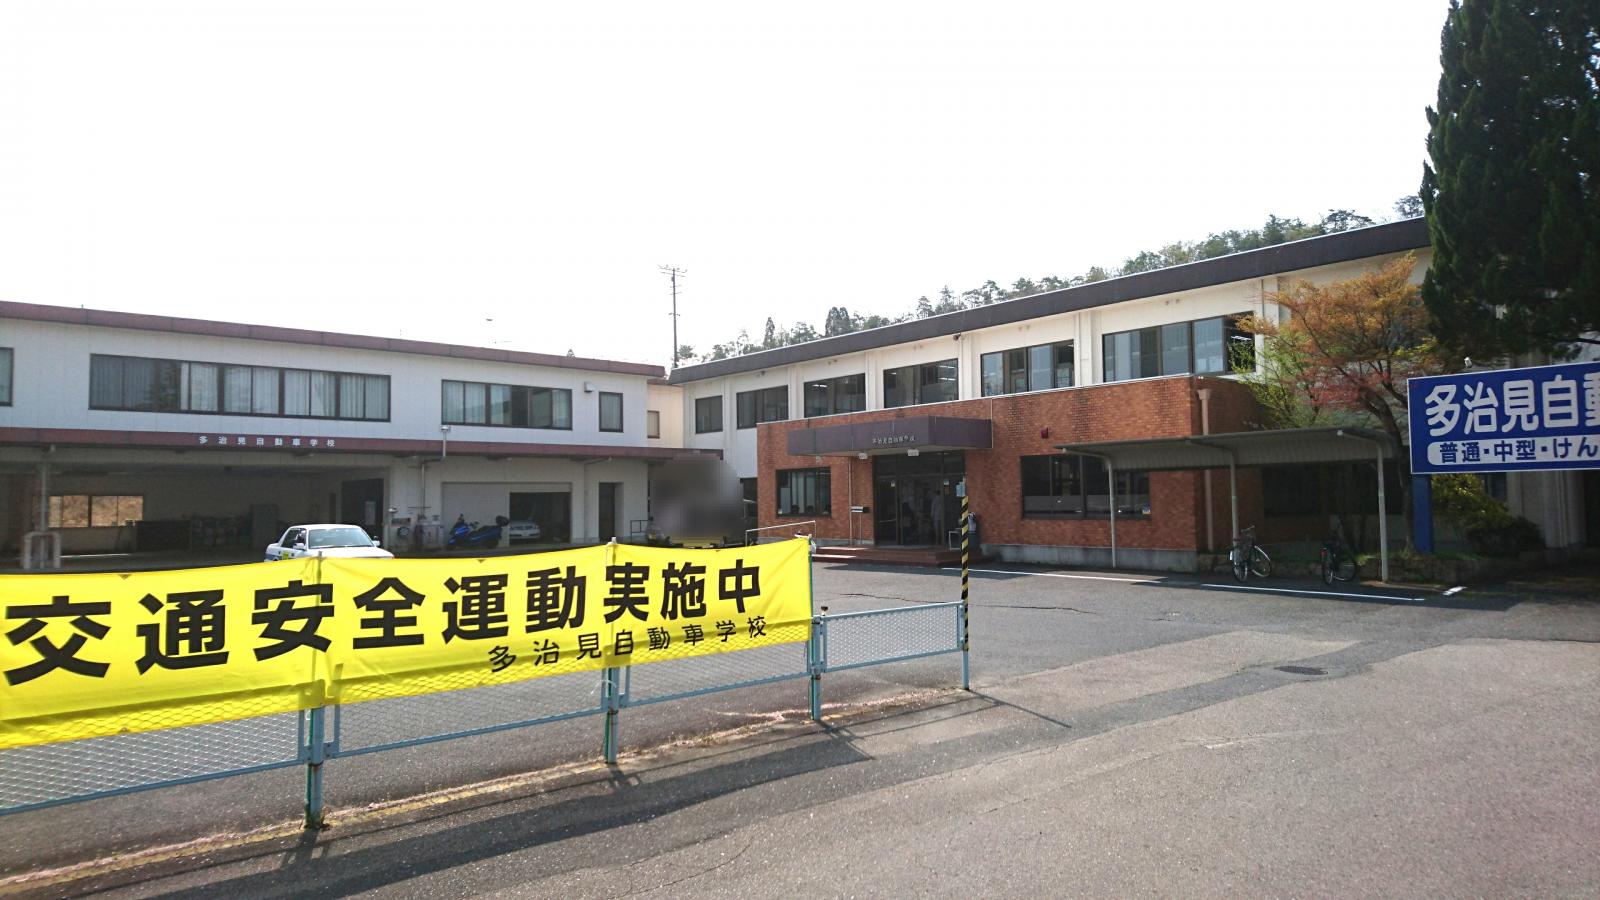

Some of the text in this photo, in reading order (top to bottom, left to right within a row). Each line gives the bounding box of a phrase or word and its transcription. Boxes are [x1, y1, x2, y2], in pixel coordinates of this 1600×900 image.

[199, 435, 336, 448] 多治見自動車学校
[3, 558, 761, 686] 交通安全運動実施中
[488, 615, 767, 673] 多治見自動車学校
